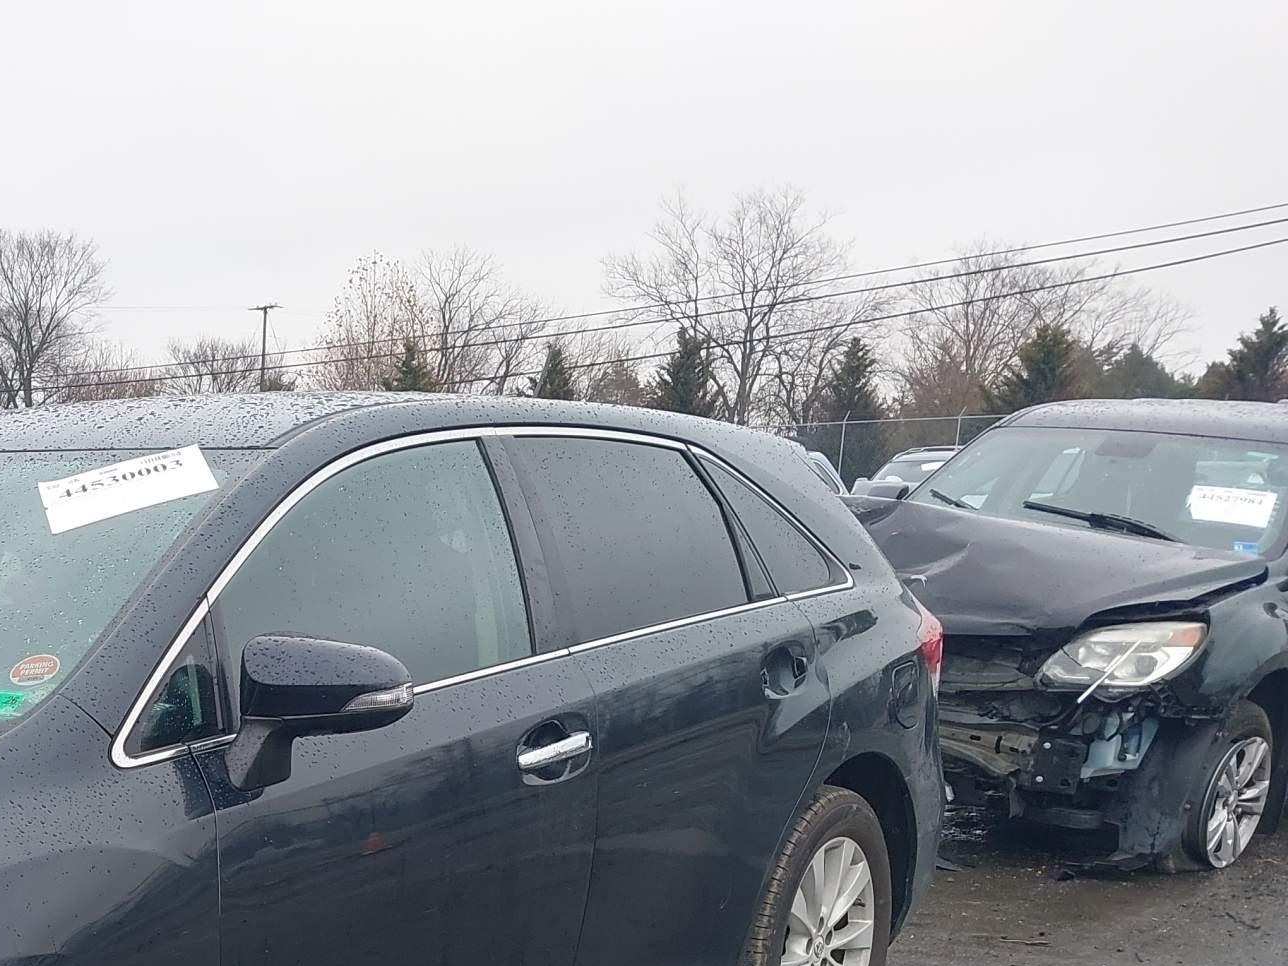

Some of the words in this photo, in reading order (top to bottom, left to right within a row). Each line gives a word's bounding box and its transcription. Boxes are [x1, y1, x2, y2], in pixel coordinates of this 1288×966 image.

[58, 459, 184, 499] 44530003
[19, 660, 54, 670] PARKING
[19, 667, 50, 677] PERMIT
